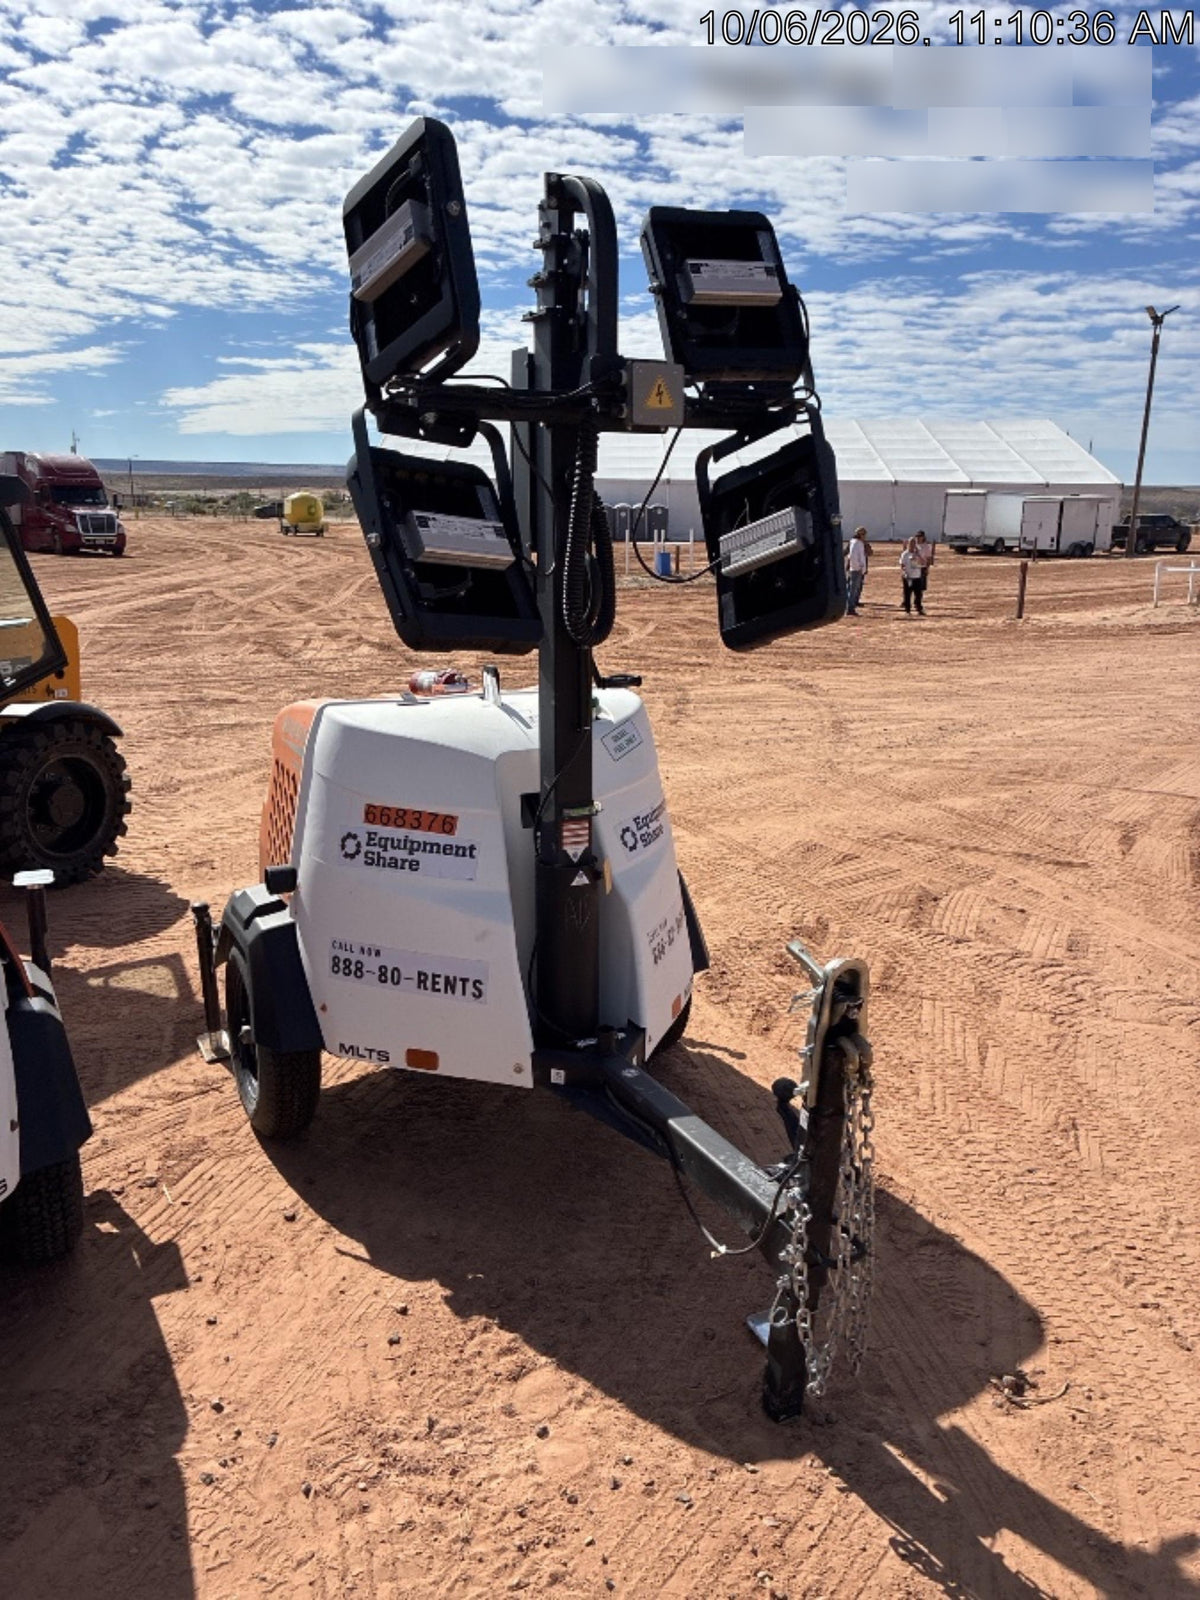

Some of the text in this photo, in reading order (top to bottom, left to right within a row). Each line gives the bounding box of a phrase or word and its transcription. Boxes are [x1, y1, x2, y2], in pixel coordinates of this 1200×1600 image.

[365, 804, 455, 834] 668376
[365, 831, 477, 859] Equipment
[364, 851, 420, 872] Share
[331, 940, 381, 957] CALL NOW
[331, 955, 484, 1000] 888-80-RENTS
[338, 1042, 390, 1062] MLTS
